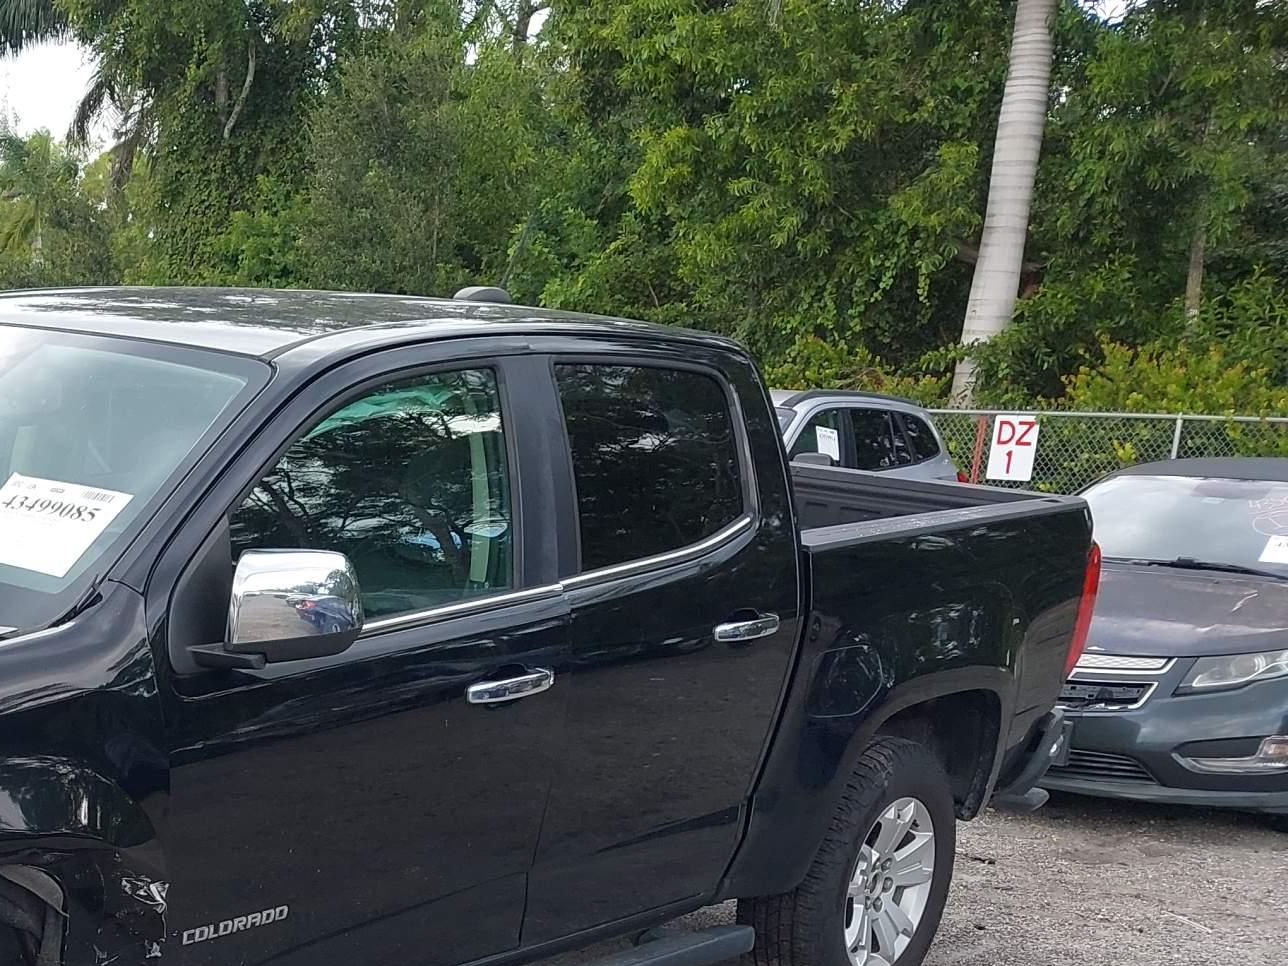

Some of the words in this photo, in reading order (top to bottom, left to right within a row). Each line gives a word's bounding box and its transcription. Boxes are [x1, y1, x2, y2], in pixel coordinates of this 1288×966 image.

[996, 420, 1036, 446] DZ
[1006, 450, 1013, 474] 1
[2, 495, 101, 522] 43499085
[182, 905, 289, 945] COLORADO
